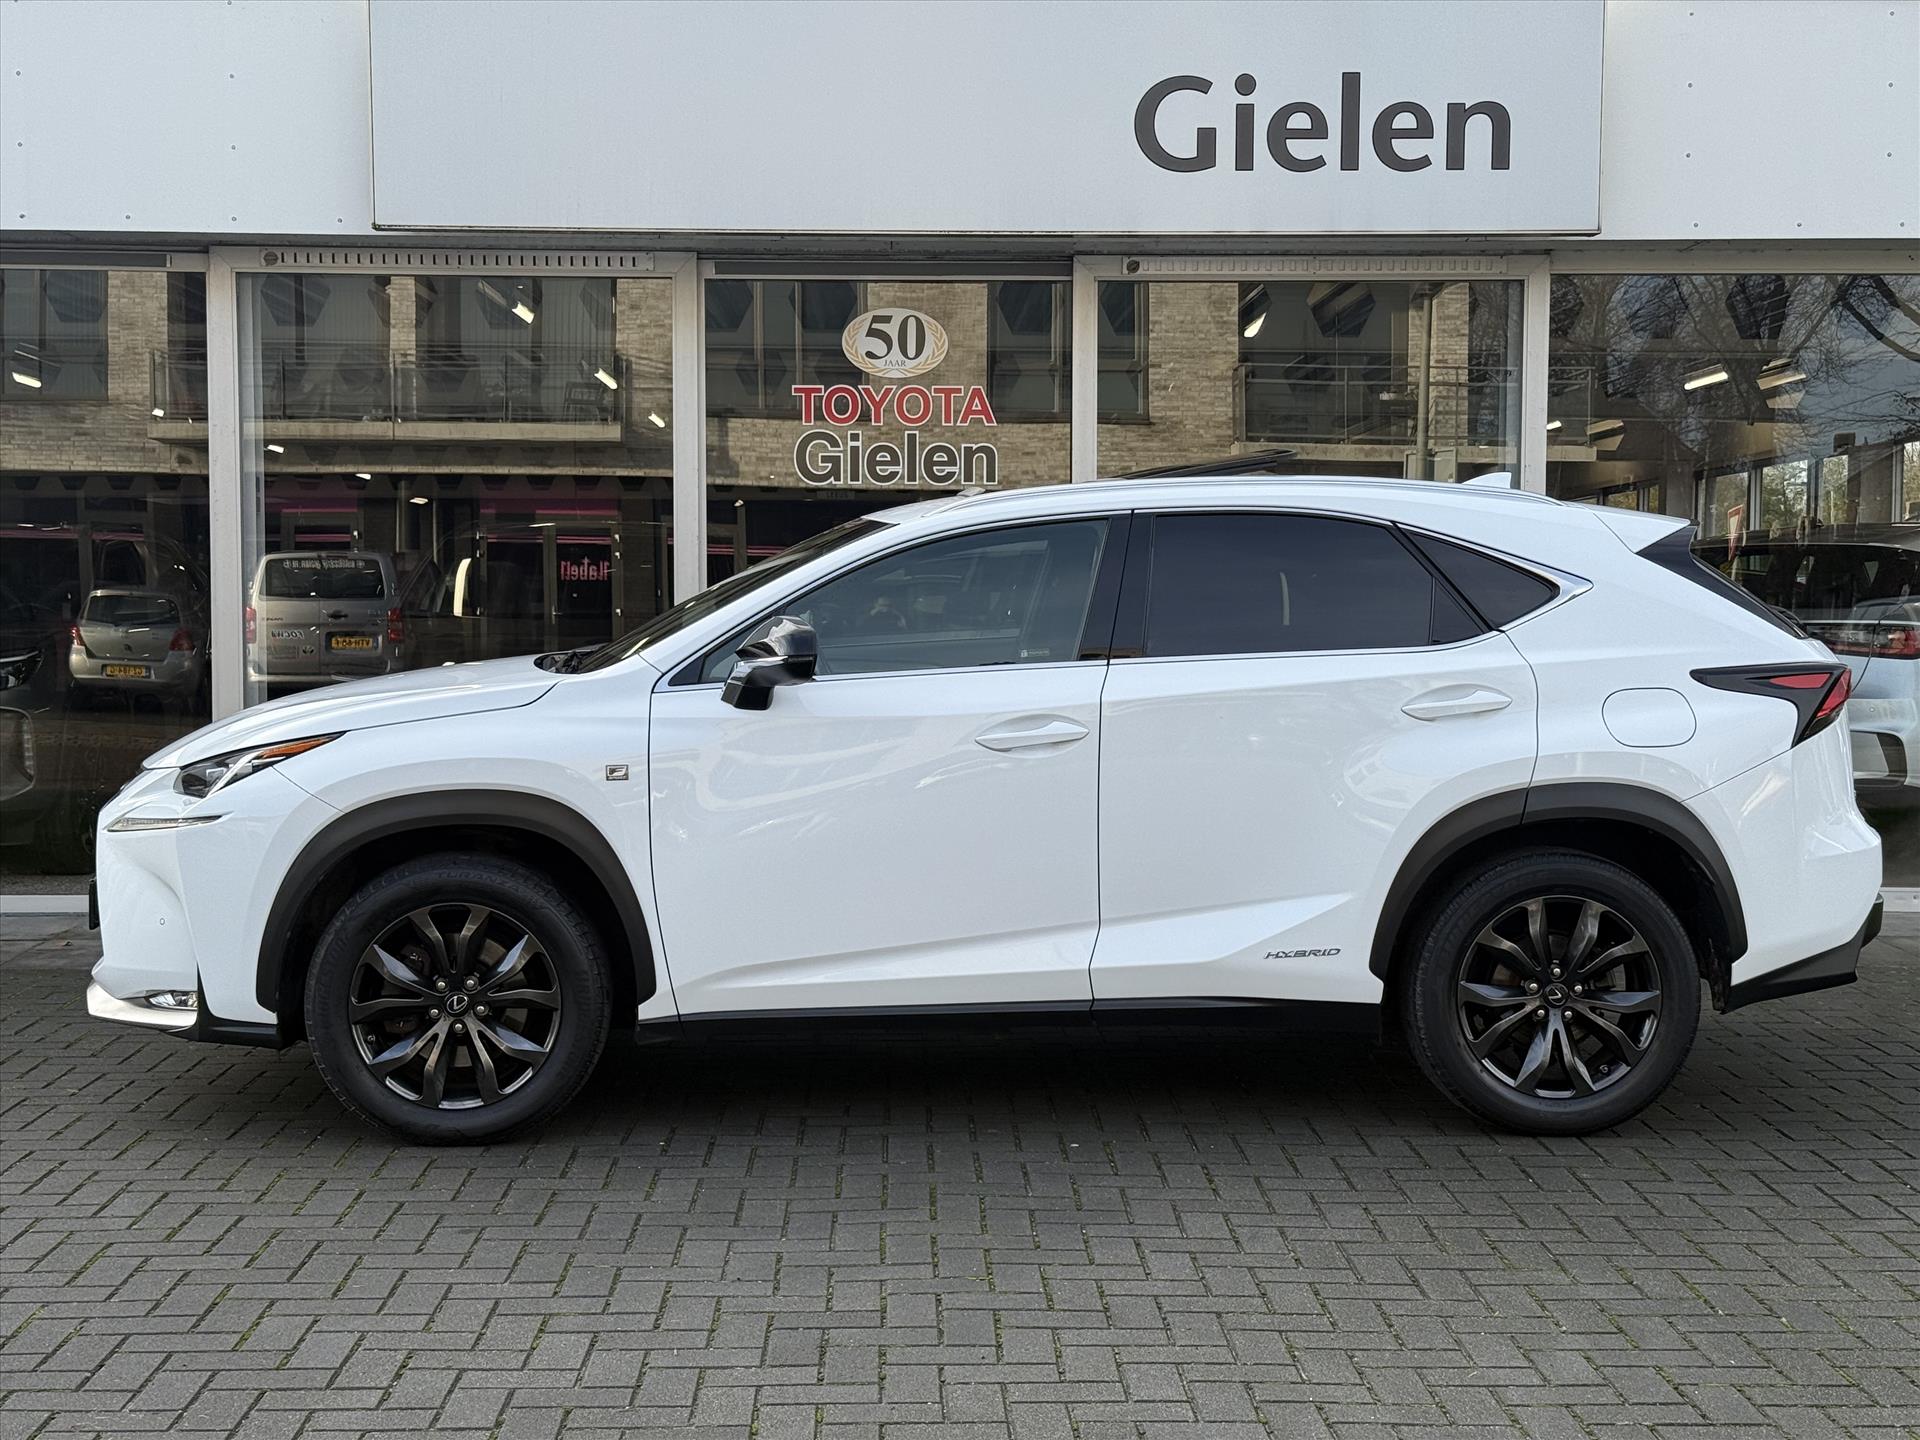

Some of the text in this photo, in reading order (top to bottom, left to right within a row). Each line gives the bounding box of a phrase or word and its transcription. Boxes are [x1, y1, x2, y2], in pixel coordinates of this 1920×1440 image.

[1134, 72, 1511, 172] Gielen
[864, 314, 926, 360] 50
[883, 359, 906, 367] JAAR
[792, 385, 998, 426] TOYOTA
[794, 429, 998, 485] Gielen
[1263, 948, 1342, 960] HYBRID
